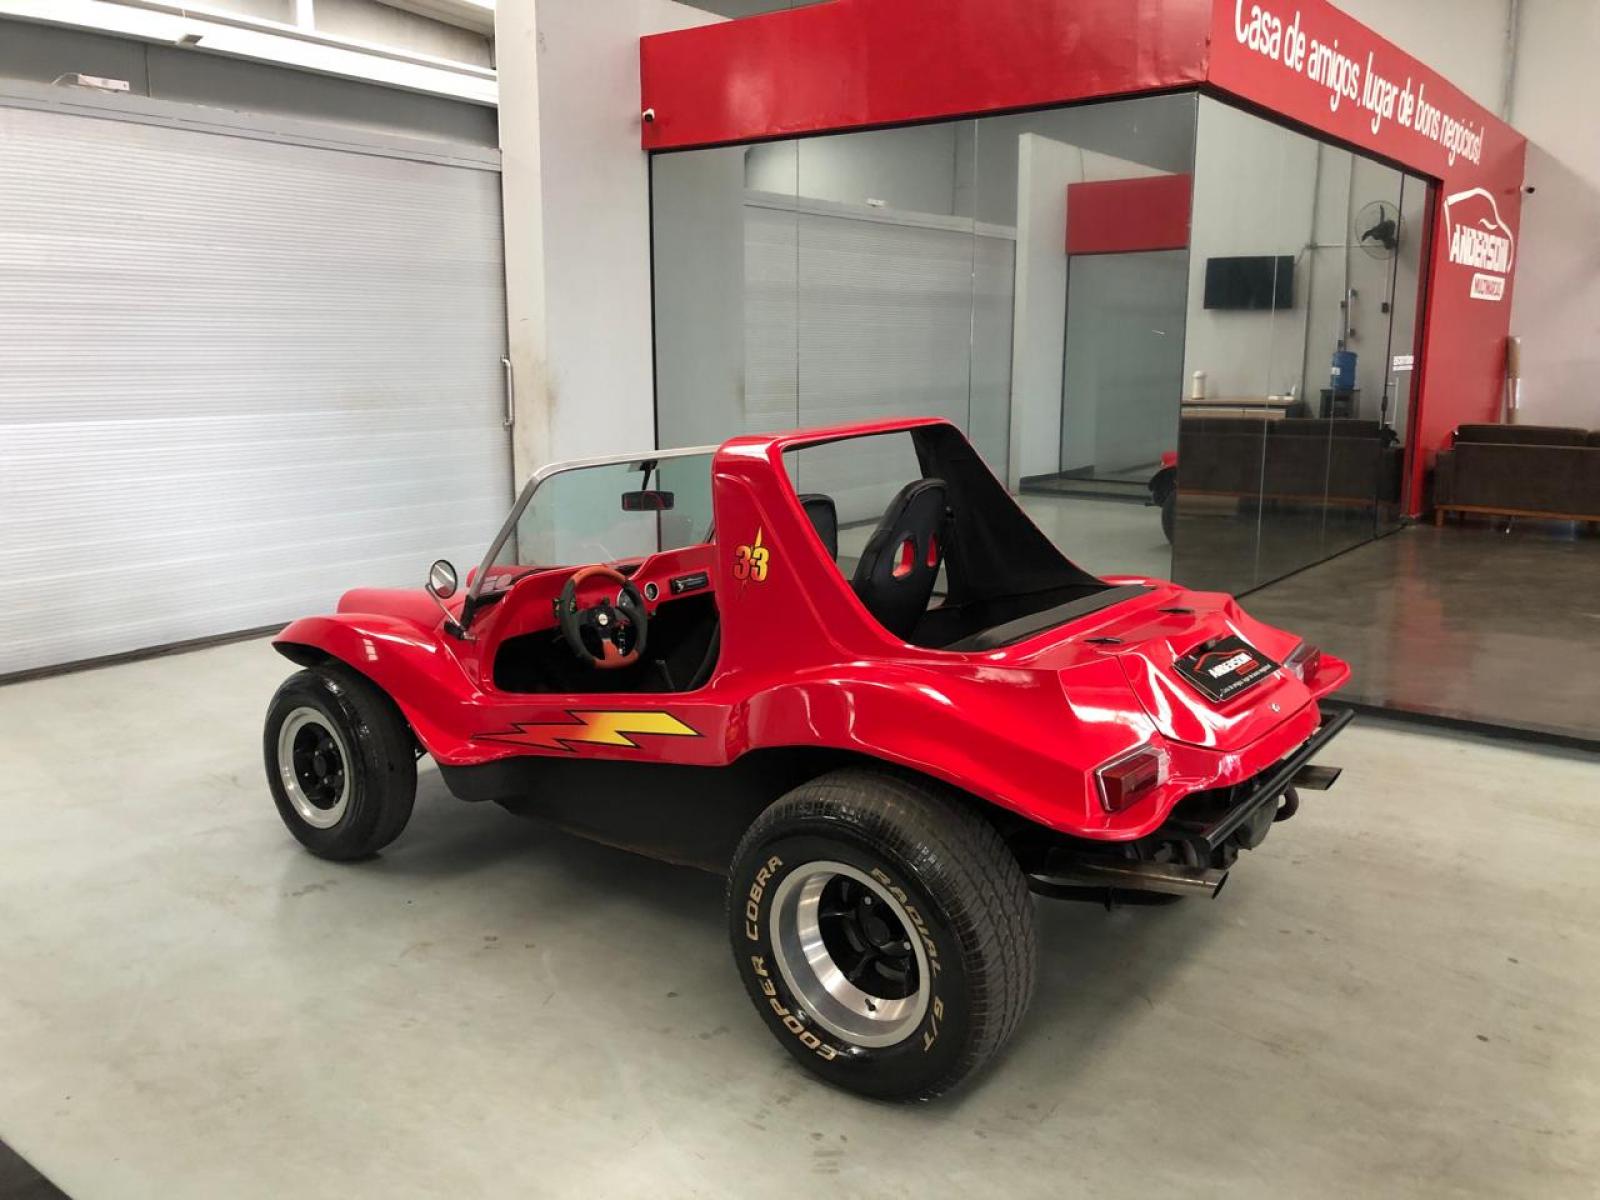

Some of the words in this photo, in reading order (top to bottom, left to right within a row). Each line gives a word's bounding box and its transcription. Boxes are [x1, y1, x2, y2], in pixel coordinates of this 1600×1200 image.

[1234, 0, 1281, 61] Casa
[1284, 10, 1306, 73] de
[1307, 39, 1360, 112] amigos,
[1362, 51, 1399, 134] lugar
[1398, 77, 1415, 127] de
[1414, 83, 1441, 141] bons
[732, 545, 770, 583] 33
[745, 855, 783, 941] COBRA
[751, 955, 838, 1061] COOPER
